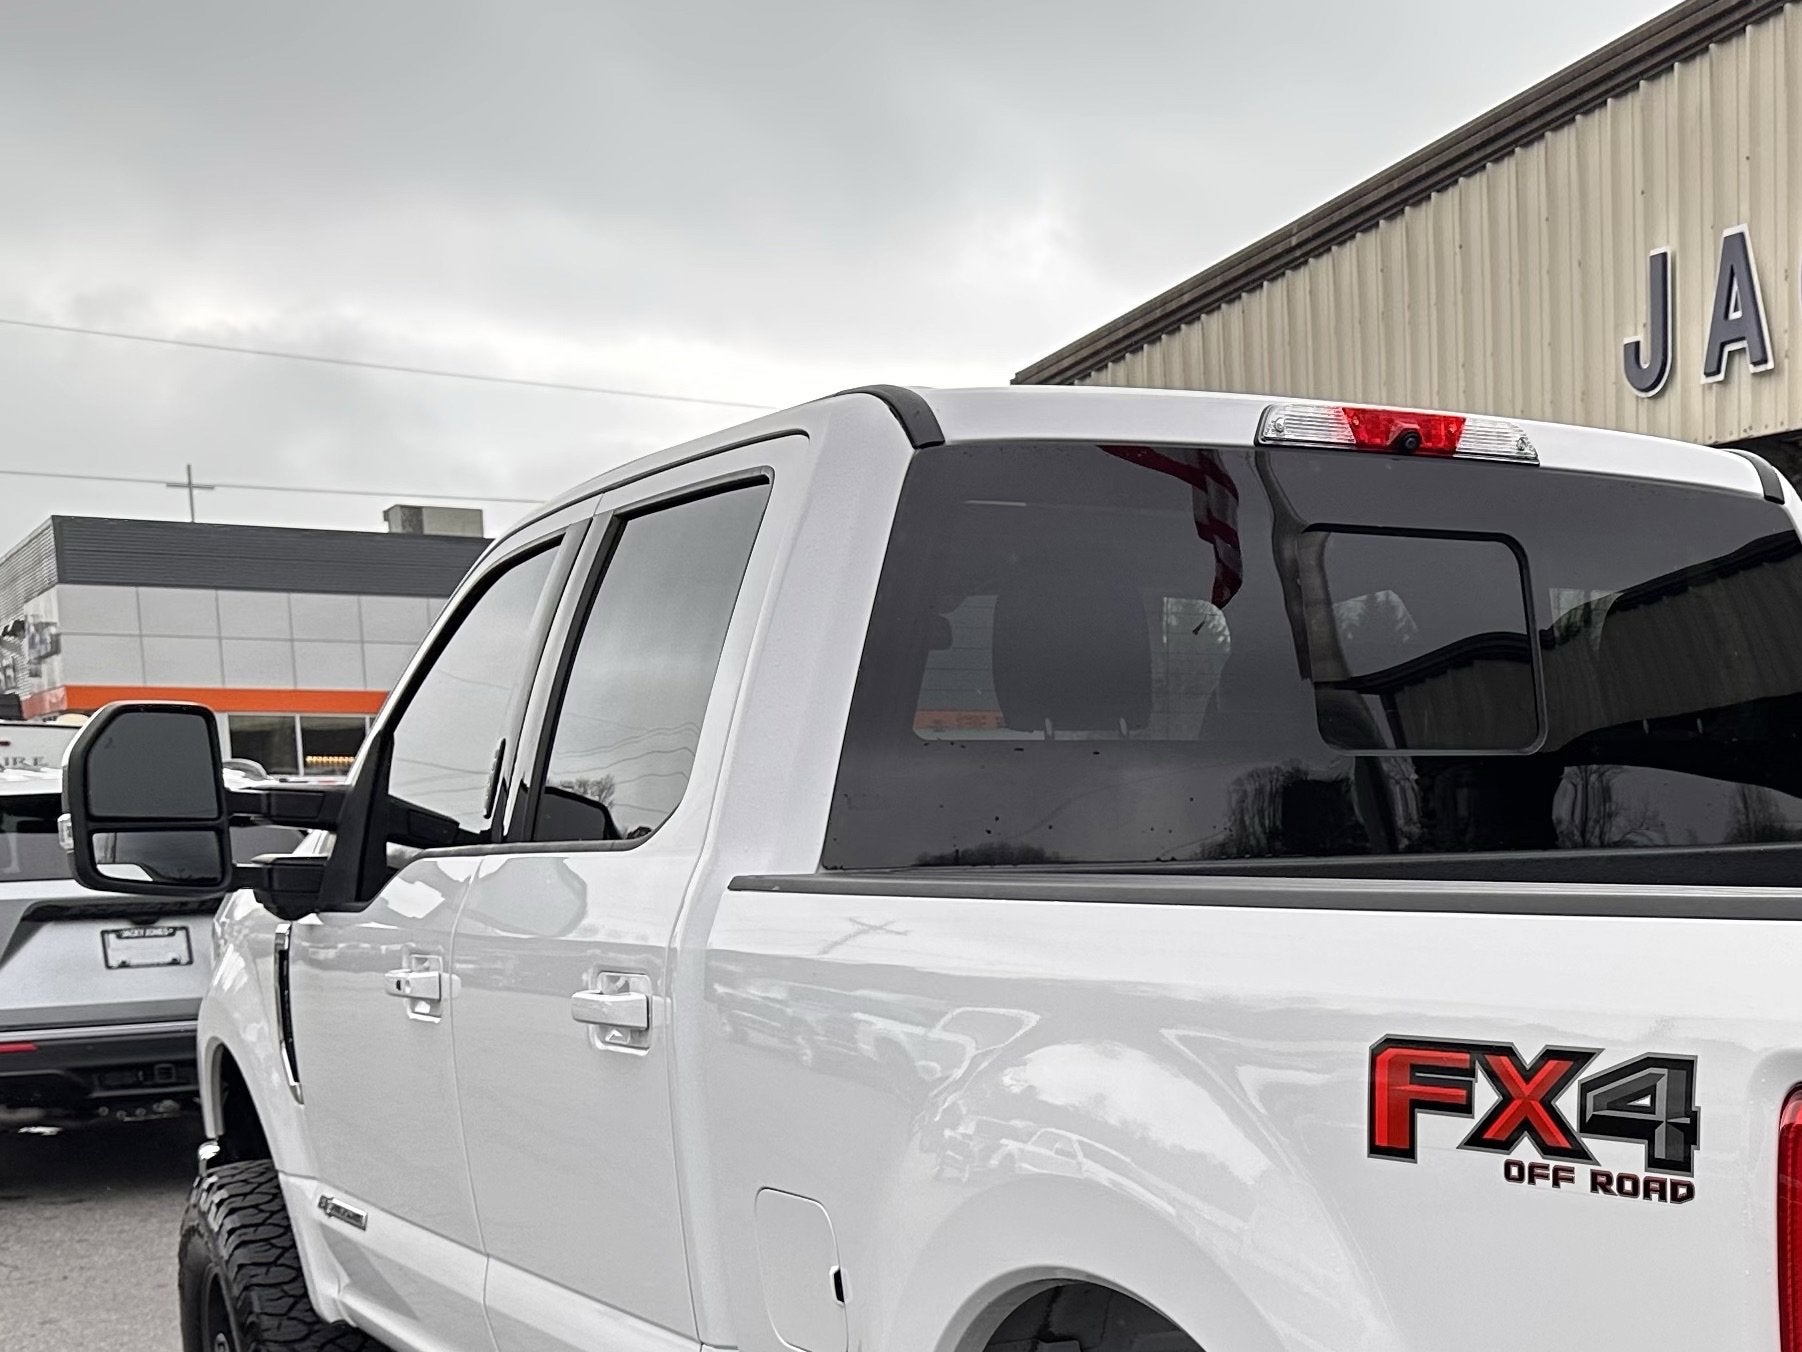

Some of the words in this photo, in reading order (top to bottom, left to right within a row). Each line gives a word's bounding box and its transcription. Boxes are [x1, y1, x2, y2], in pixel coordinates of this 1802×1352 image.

[1367, 1033, 1701, 1178] FX4
[1503, 1158, 1576, 1190] OFF
[1589, 1168, 1697, 1206] ROAD
